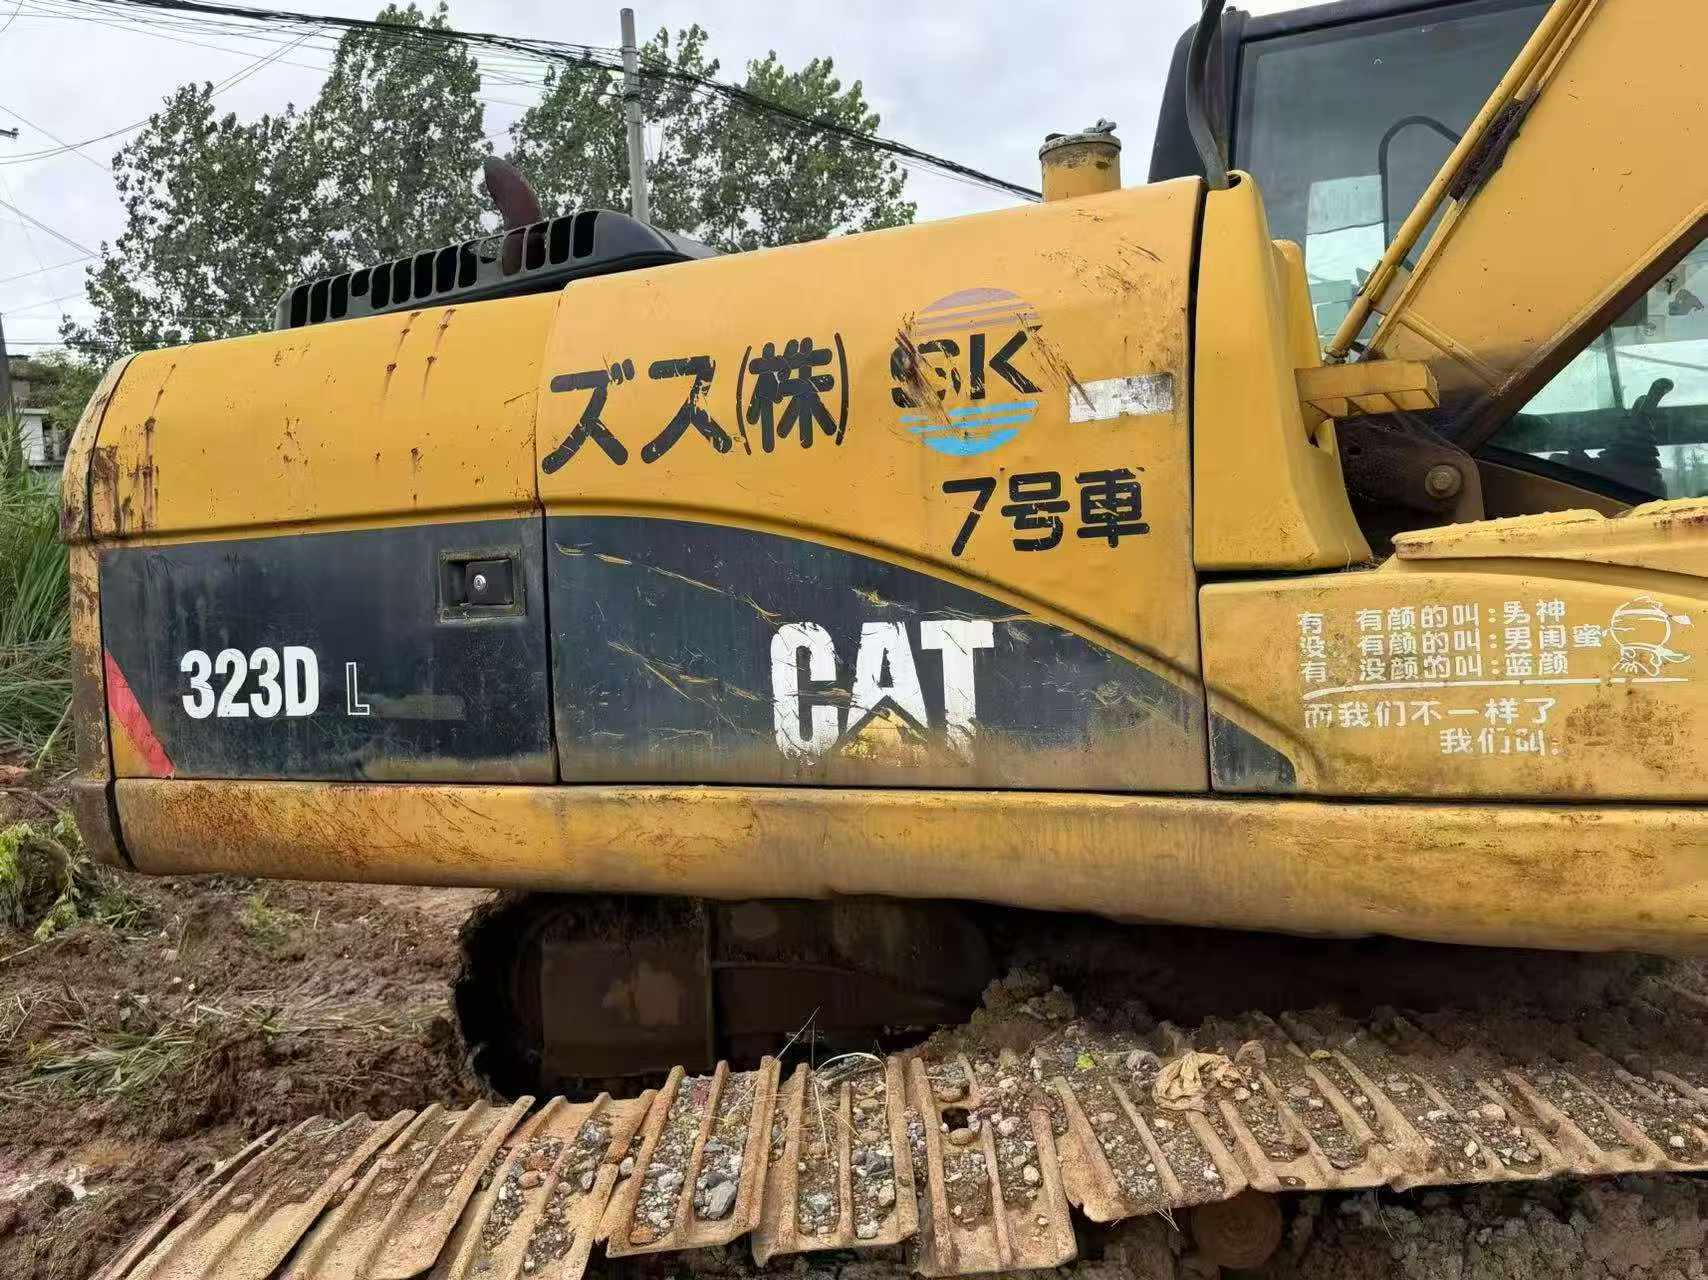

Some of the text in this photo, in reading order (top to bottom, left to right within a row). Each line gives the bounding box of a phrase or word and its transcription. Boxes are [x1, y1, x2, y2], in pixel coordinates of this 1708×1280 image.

[942, 467, 1151, 557] 7号車
[180, 646, 371, 720] 323D L
[770, 619, 994, 766] CAT
[1304, 697, 1556, 729] 而我们不一样了
